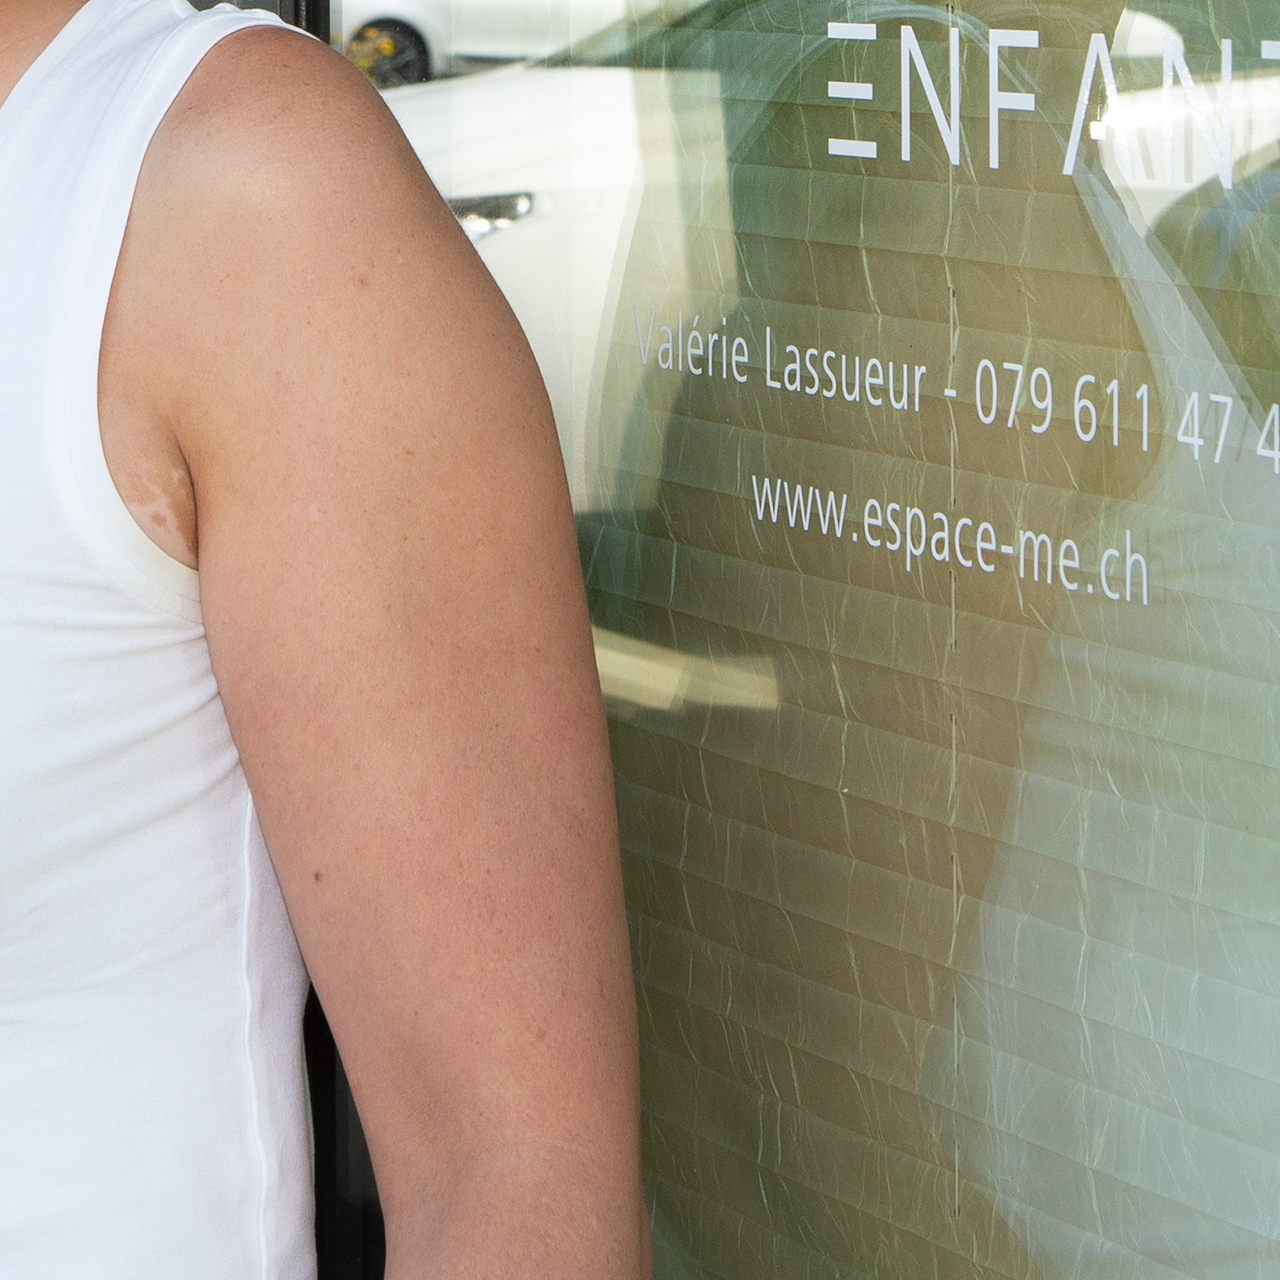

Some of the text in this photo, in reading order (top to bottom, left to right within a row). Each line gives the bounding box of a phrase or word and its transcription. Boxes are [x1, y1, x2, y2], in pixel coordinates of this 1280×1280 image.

[632, 305, 750, 383] Valérie
[766, 326, 926, 412] Lassueur
[975, 358, 1053, 435] 079
[1073, 375, 1150, 452] 611
[1177, 391, 1233, 463] 47
[752, 474, 1148, 606] www.espace-me.ch
